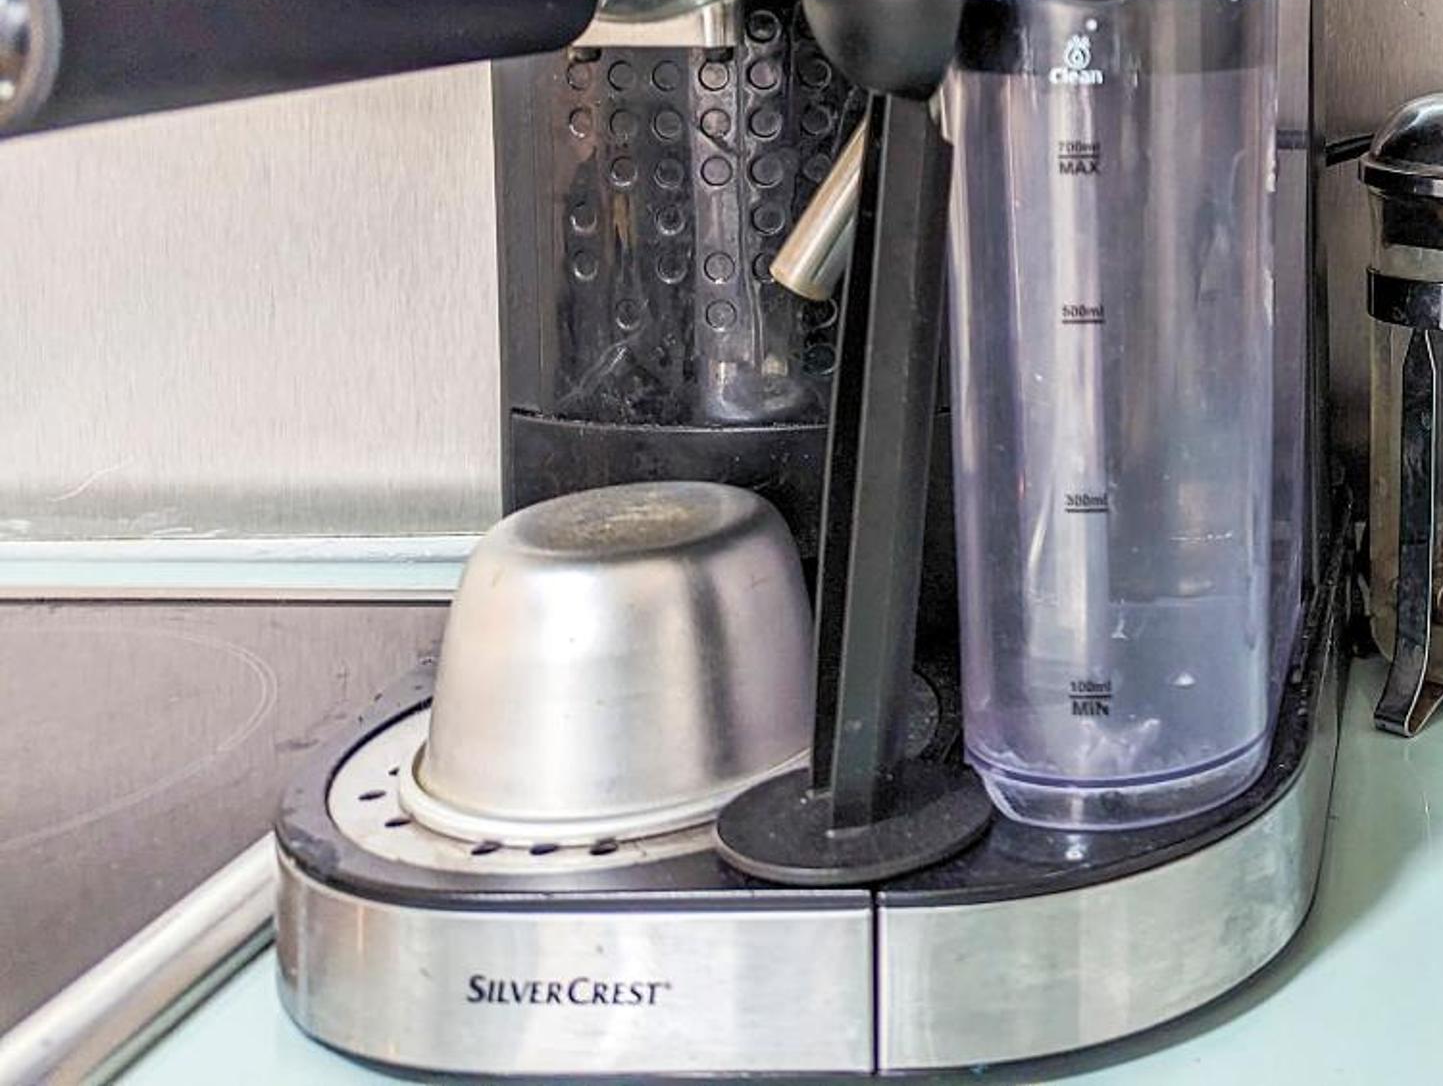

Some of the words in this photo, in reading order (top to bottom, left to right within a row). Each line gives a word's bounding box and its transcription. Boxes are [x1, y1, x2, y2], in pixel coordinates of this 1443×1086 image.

[1049, 67, 1103, 85] Clean
[1058, 160, 1099, 175] MAX
[1071, 700, 1110, 715] MIN
